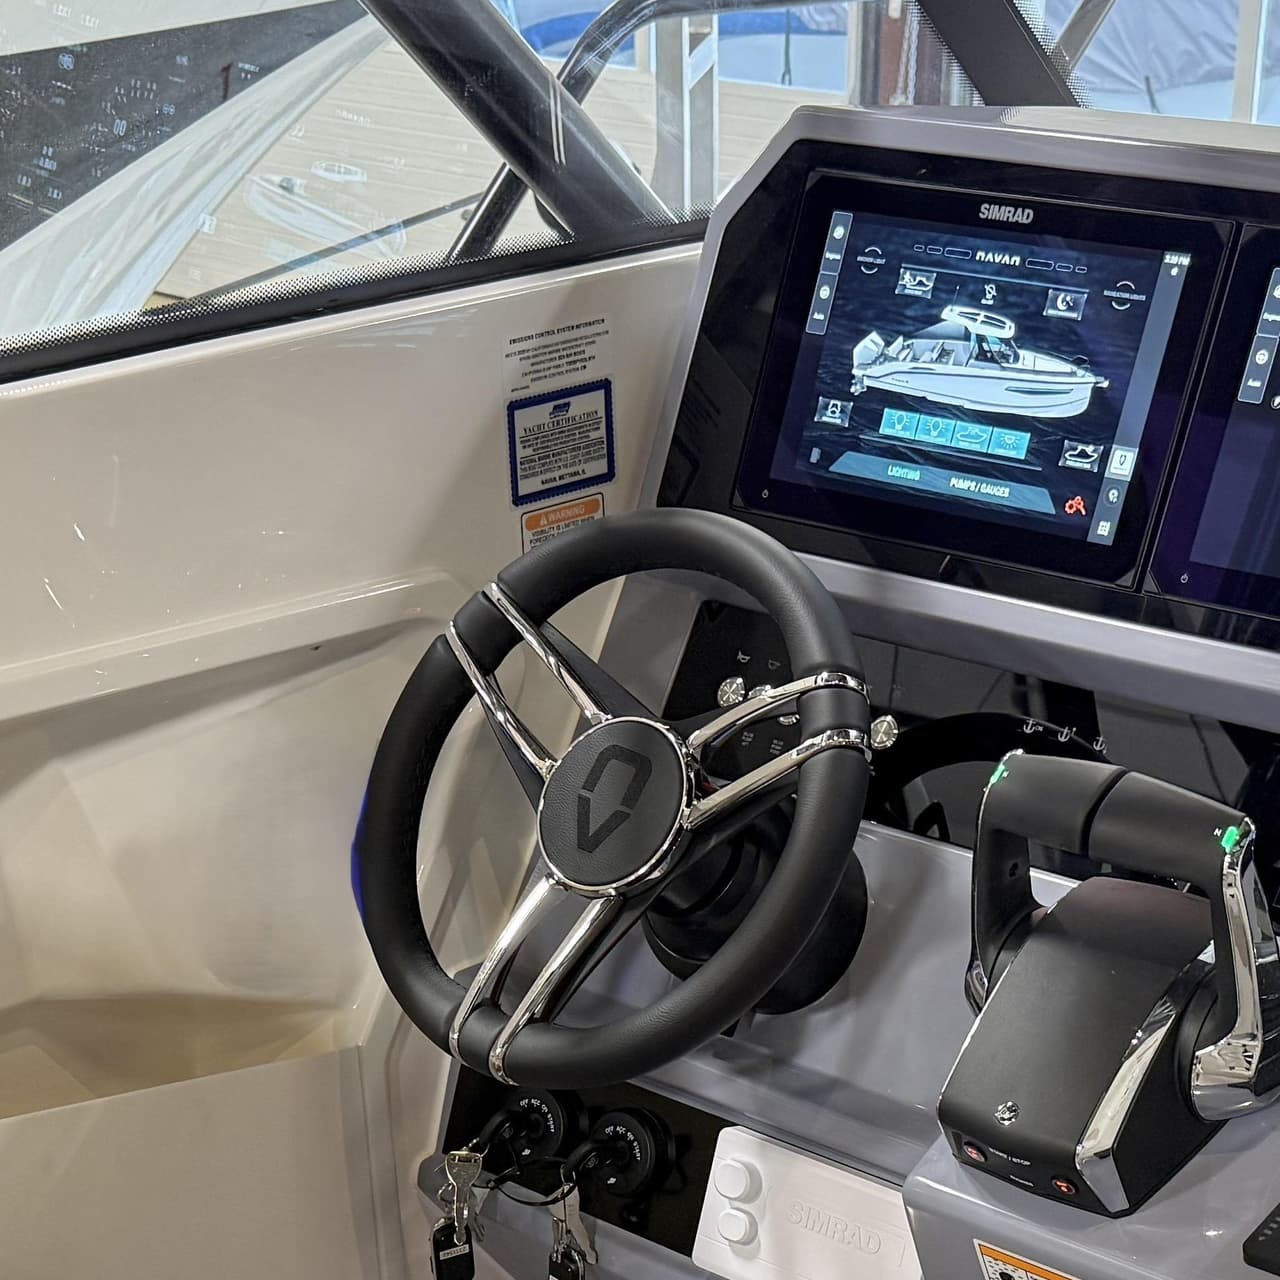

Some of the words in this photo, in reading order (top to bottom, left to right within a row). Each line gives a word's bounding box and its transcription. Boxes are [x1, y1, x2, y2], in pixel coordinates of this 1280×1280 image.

[979, 203, 1034, 224] SIMRAD
[887, 464, 921, 481] LIGHTING
[549, 504, 585, 522] WARNING
[787, 1199, 882, 1256] SIMRAD
